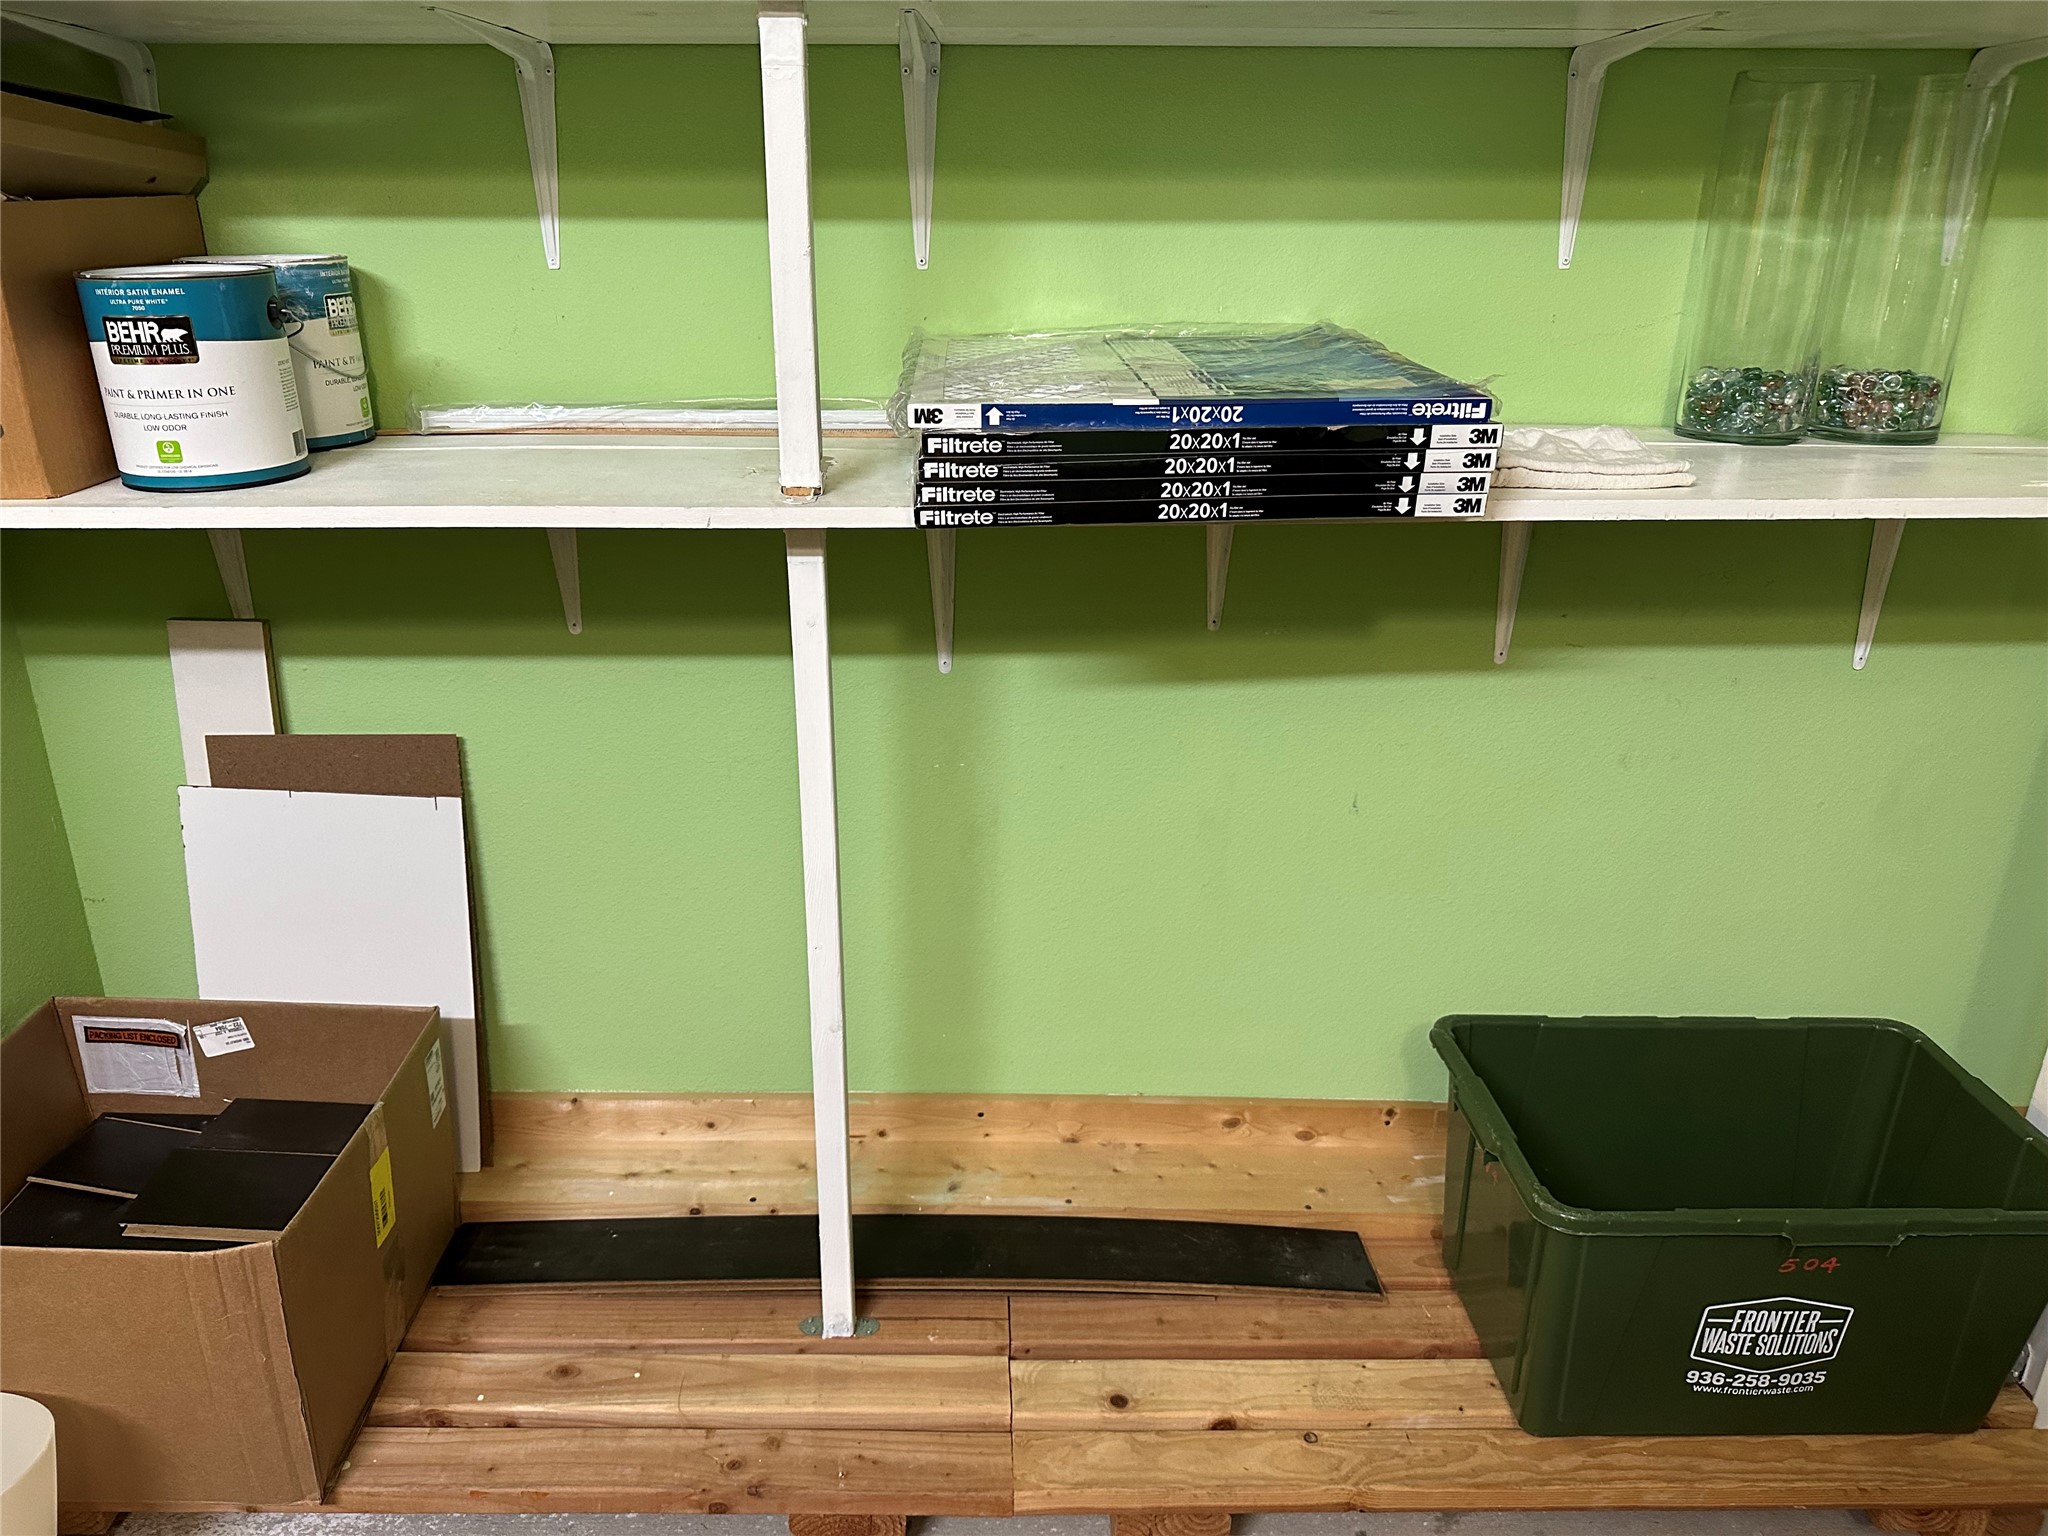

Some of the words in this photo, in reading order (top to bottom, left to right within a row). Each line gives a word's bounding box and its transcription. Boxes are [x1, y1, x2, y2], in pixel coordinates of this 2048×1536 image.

[94, 288, 125, 296] INTERIOR
[126, 288, 150, 296] SATIN
[151, 288, 186, 296] ENAMEL
[105, 320, 162, 343] BEHR
[111, 344, 159, 356] PREMIUM
[161, 343, 190, 356] PLUS
[312, 357, 341, 369] PAINT
[342, 356, 349, 366] &
[104, 386, 125, 399] PAINT
[127, 389, 136, 399] &
[137, 387, 186, 400] PRIMER
[187, 388, 203, 398] IN
[207, 385, 237, 397] ONE
[200, 410, 229, 419] FINISH
[914, 407, 944, 425] 3M
[1171, 405, 1244, 424] 20x20x1
[1412, 402, 1489, 419] Filtrete
[143, 424, 160, 432] LOW
[161, 424, 188, 432] ODOR
[1468, 428, 1498, 444] 3M
[927, 437, 1003, 454] Filtrete
[1169, 432, 1241, 450] 20x20x1
[1164, 456, 1235, 475] 20x20x1
[1462, 452, 1492, 469] 3M
[923, 462, 999, 479] Filtrete
[1160, 480, 1231, 498] 20x20x1
[1456, 476, 1486, 492] 3M
[921, 486, 996, 503] Filtrete
[1157, 502, 1228, 519] 20x20x1
[1452, 498, 1483, 514] 3M
[919, 510, 994, 526] Filtrete
[88, 1030, 121, 1041] PACKING
[122, 1032, 138, 1041] LIST
[140, 1033, 177, 1045] ENCLOSED
[1778, 1256, 1841, 1274] 504
[1730, 1309, 1822, 1333] FRONTIER
[1700, 1327, 1756, 1356] WASTE
[1754, 1328, 1839, 1356] SOLUTIONS
[1685, 1370, 1827, 1388] 936-258-9035
[1692, 1384, 1814, 1396] www.frontierwaste.com
